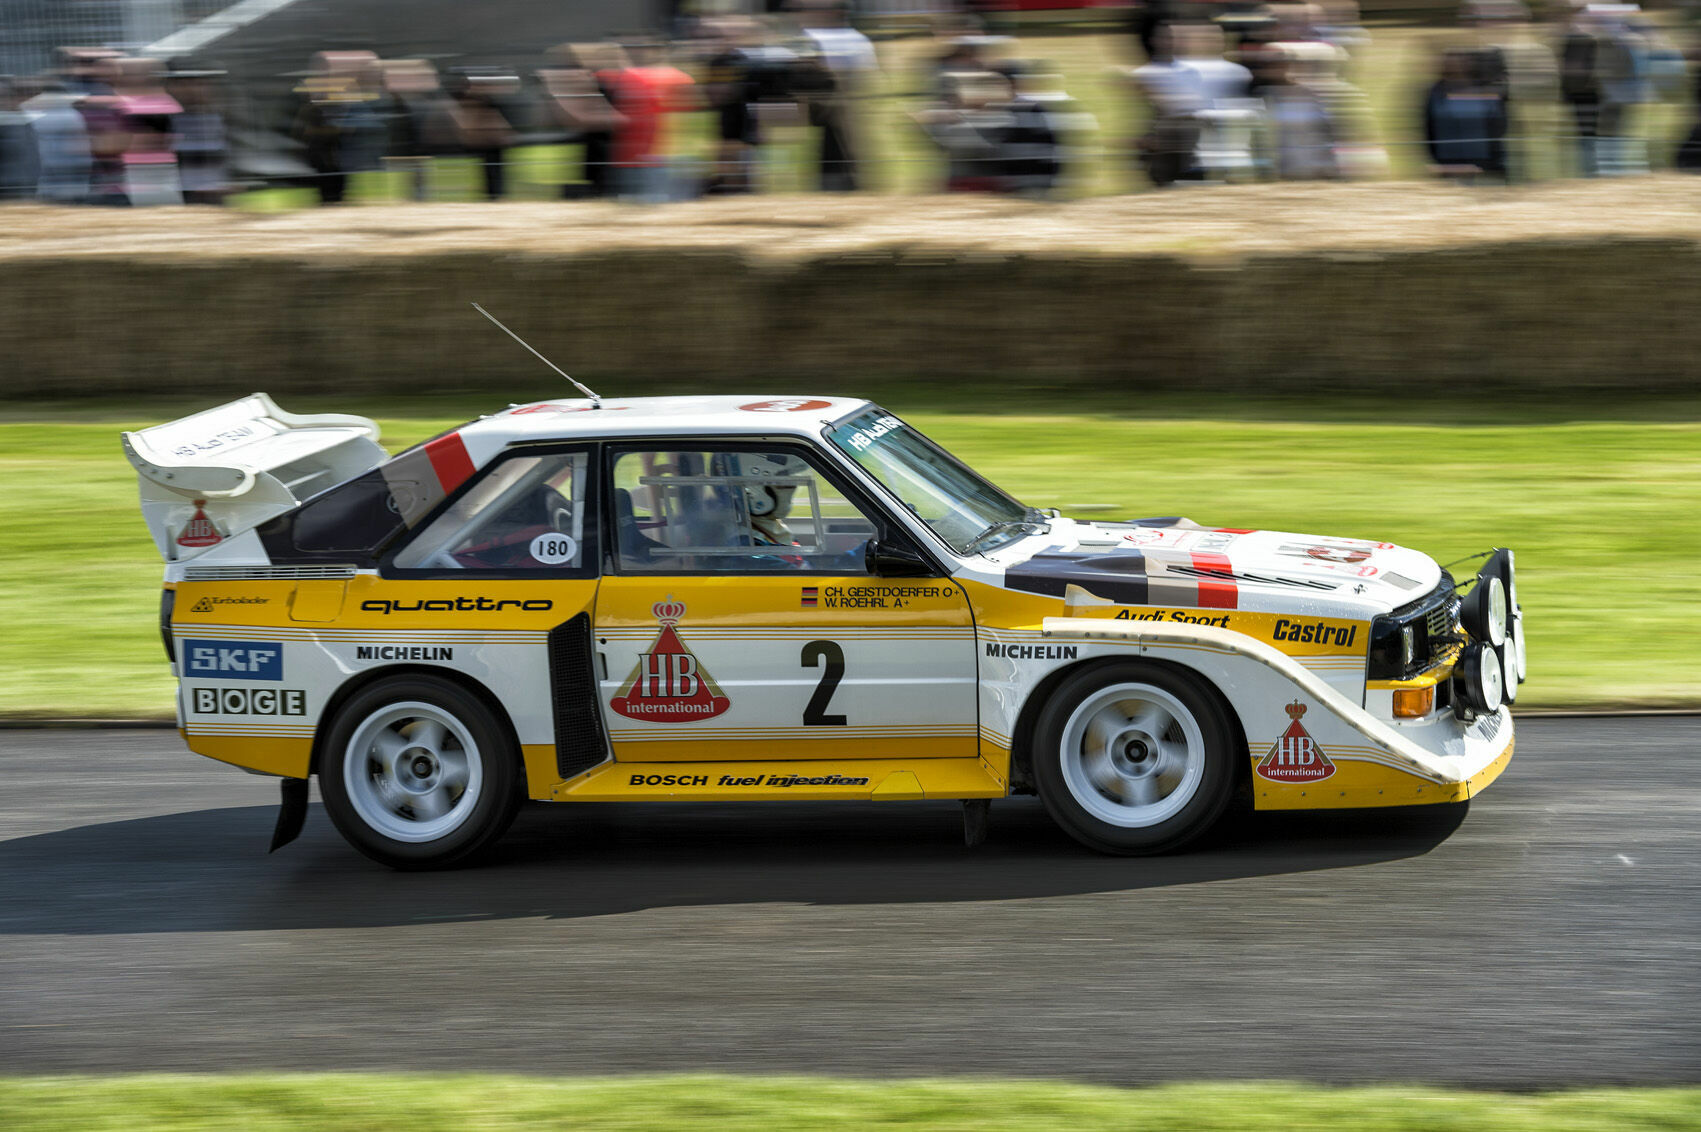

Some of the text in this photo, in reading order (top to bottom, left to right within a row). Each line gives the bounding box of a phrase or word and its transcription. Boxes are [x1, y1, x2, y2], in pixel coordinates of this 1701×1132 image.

[847, 432, 872, 451] HB
[187, 519, 213, 537] HB
[537, 540, 569, 557] 180
[824, 587, 845, 597] CH.
[847, 587, 940, 597] GEISTDOERFER
[361, 597, 553, 614] quattro
[824, 598, 838, 608] W.
[840, 598, 889, 608] ROEHRL
[1114, 609, 1166, 622] Audi
[1273, 619, 1358, 647] Castrol
[191, 648, 276, 671] SKF
[356, 646, 454, 661] MICHELIN
[986, 643, 1078, 660] MICHELIN
[638, 653, 699, 698] HB
[801, 640, 847, 726] 2
[197, 690, 301, 714] BOGE
[626, 701, 715, 713] international
[1277, 736, 1316, 766] HB
[1267, 767, 1325, 776] international
[629, 775, 869, 788] BOSCH fuel injection
